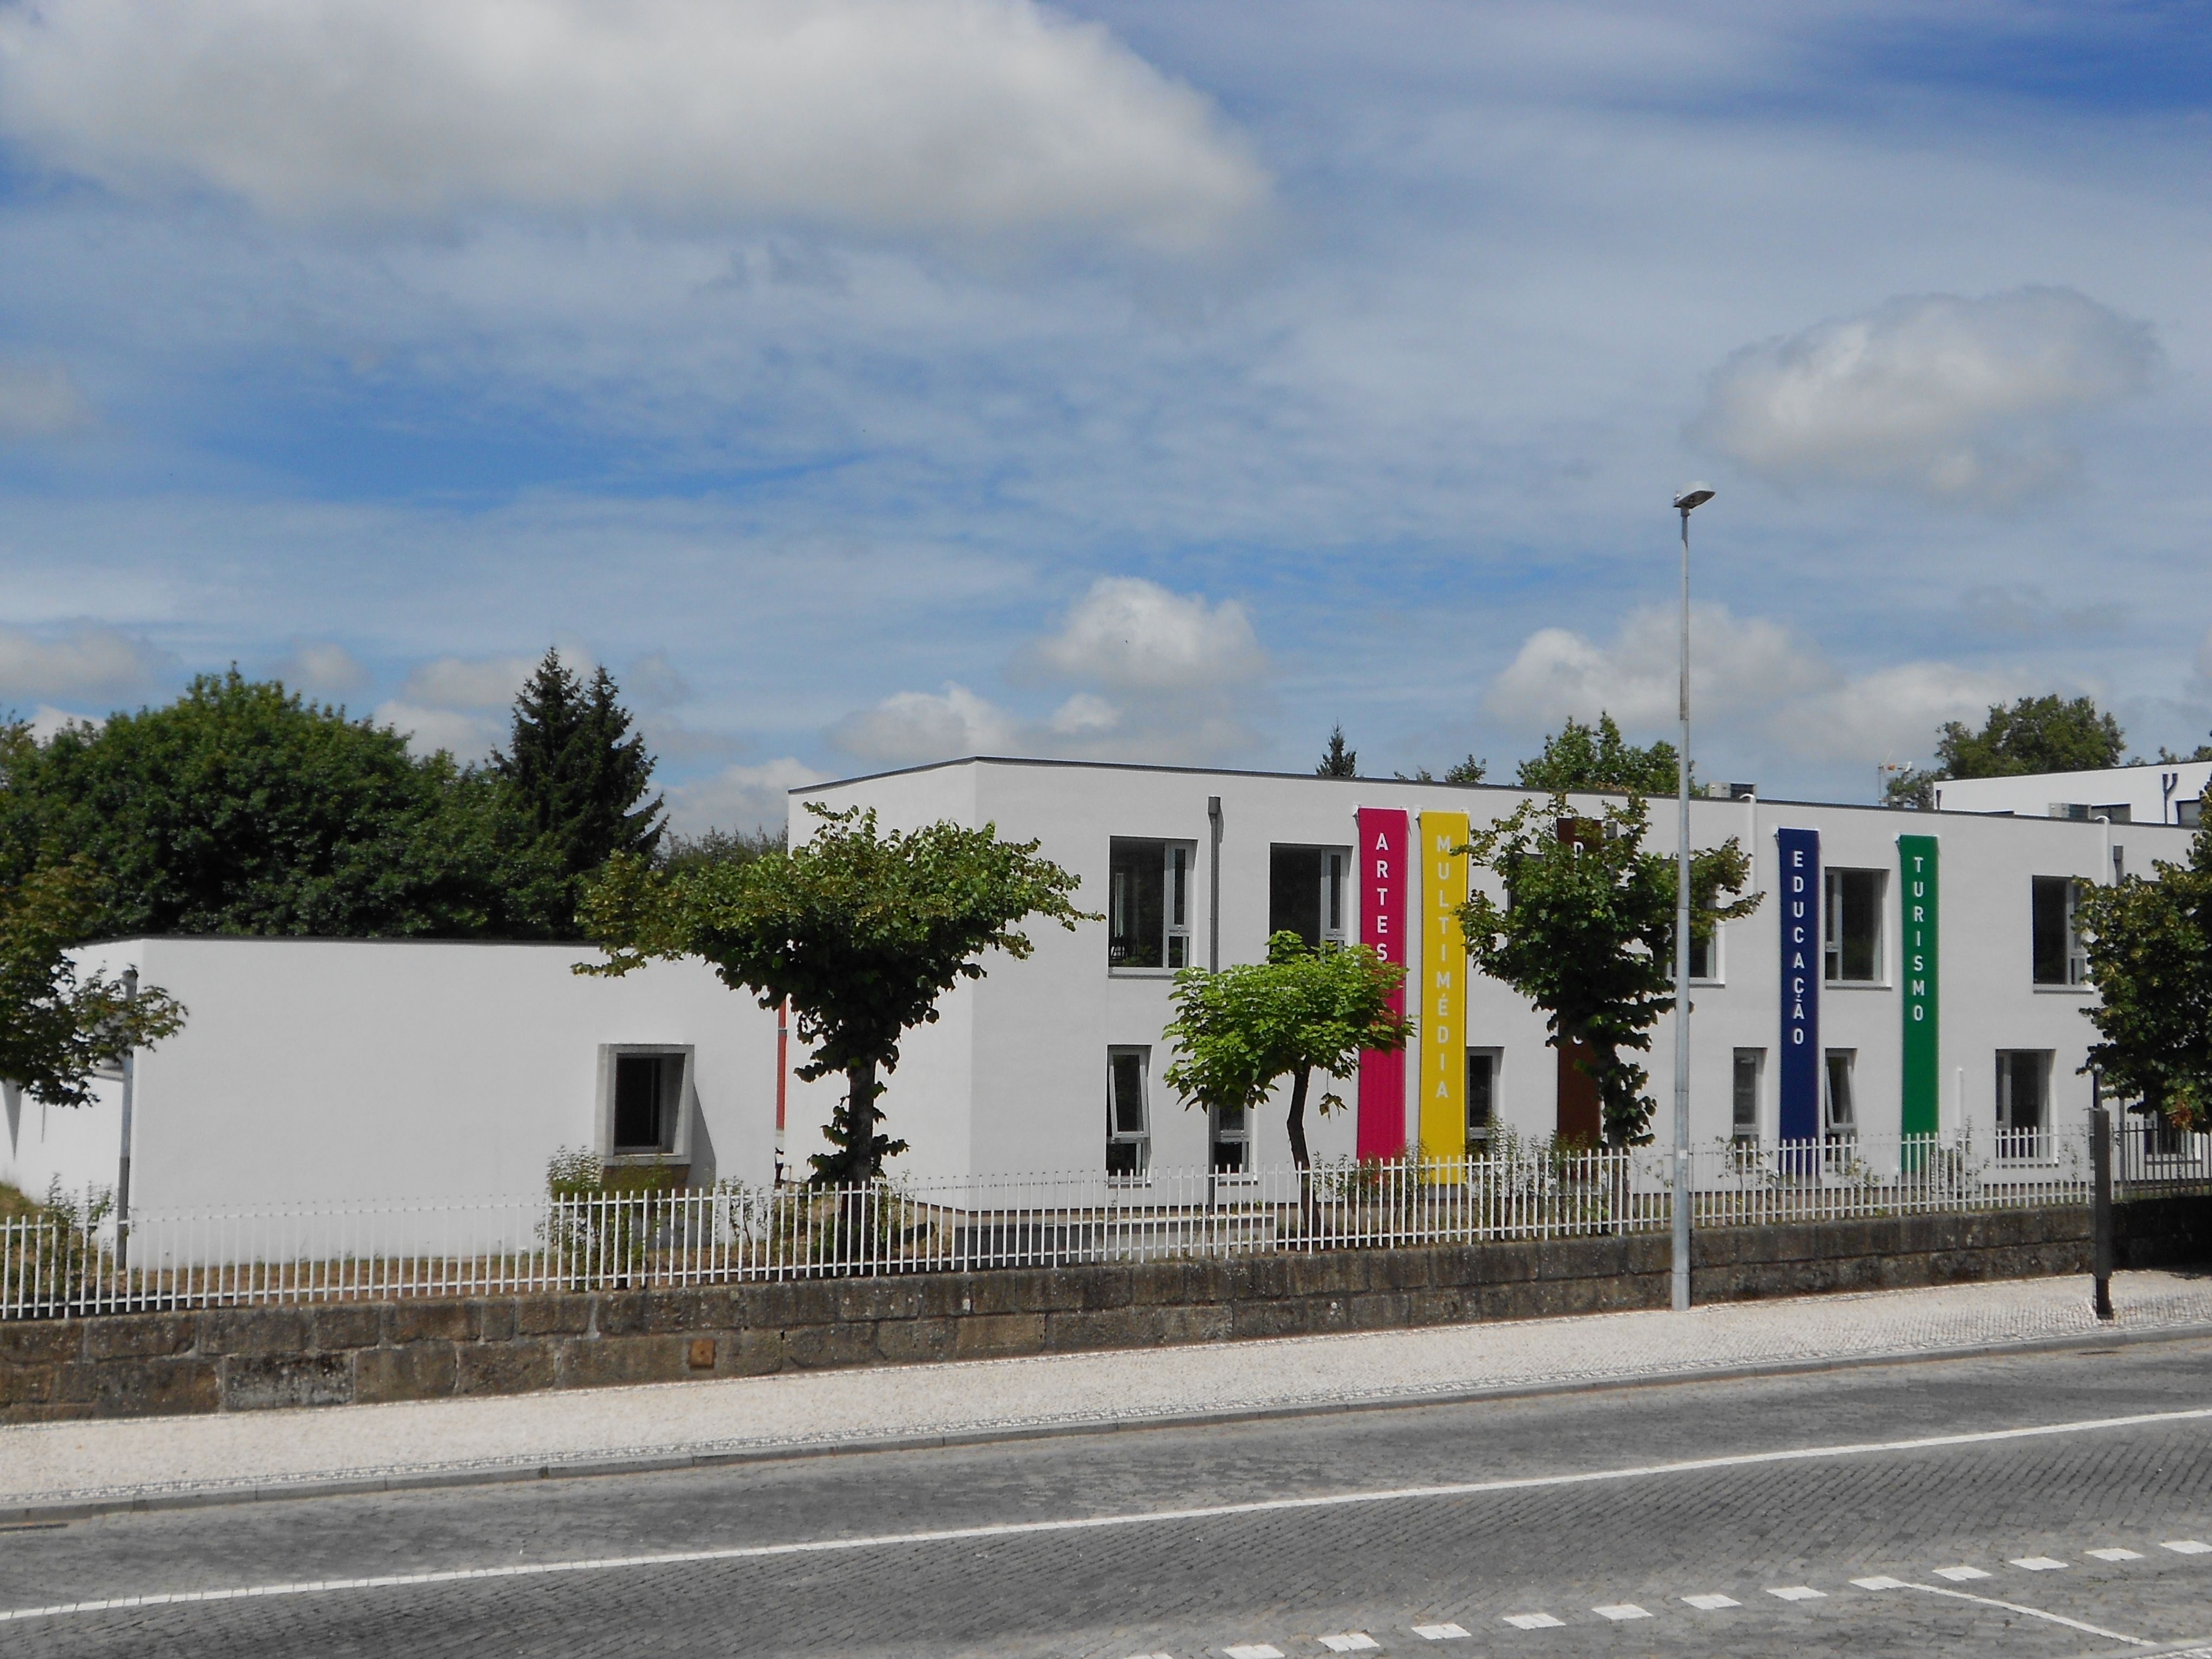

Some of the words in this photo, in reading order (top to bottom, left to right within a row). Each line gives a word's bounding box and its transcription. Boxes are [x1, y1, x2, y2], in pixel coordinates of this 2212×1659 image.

[1375, 832, 1388, 961] ARTES
[1435, 835, 1451, 1098] MULTIMÉDIA
[1793, 851, 1805, 1045] EDUCAÇÃO
[1913, 857, 1925, 1022] TURISMO
